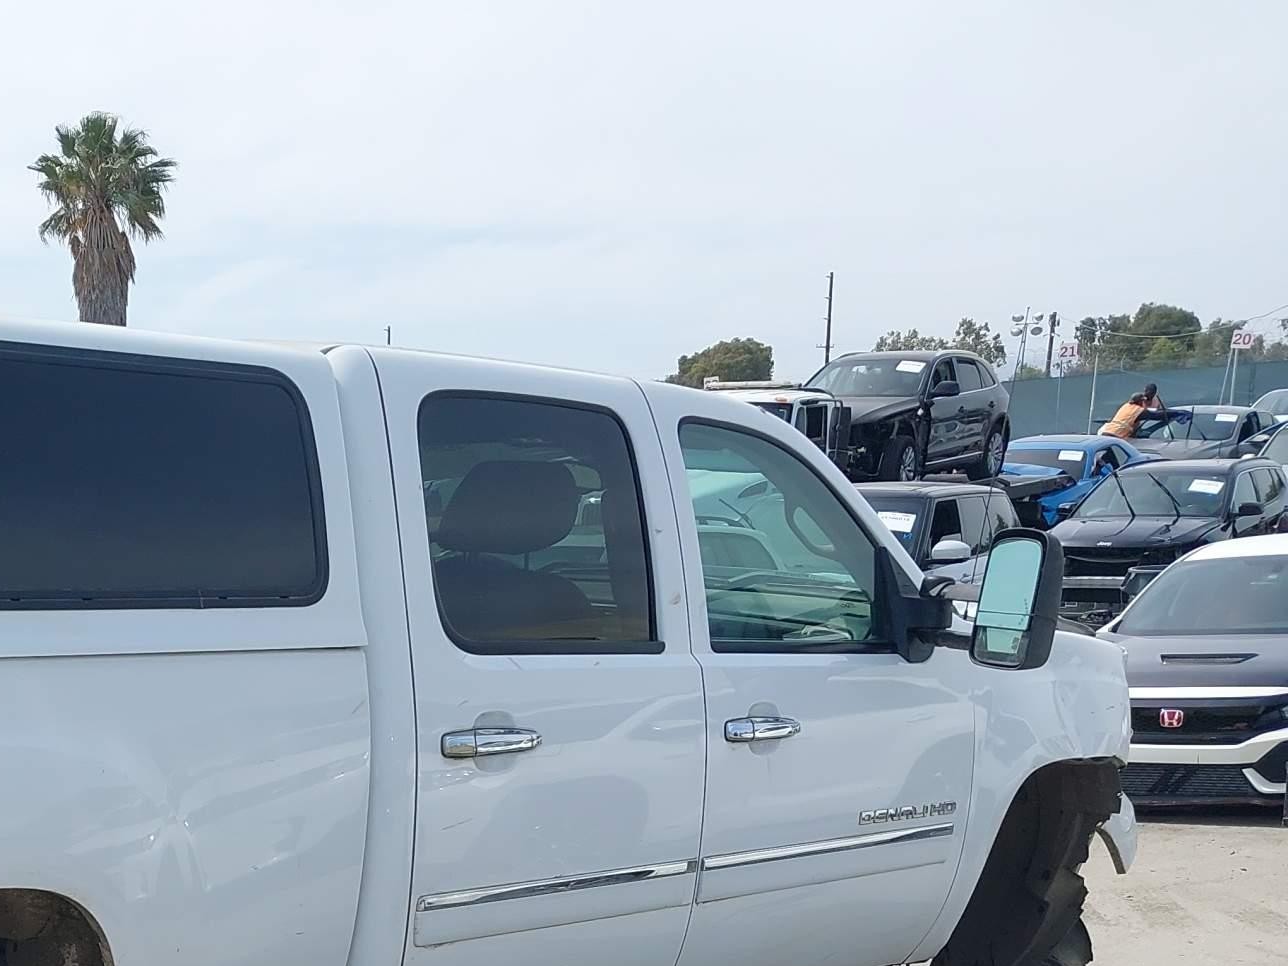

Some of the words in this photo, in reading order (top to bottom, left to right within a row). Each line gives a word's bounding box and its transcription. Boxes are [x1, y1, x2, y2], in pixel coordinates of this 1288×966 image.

[1232, 332, 1253, 346] 20
[1059, 345, 1077, 358] 21
[858, 805, 929, 826] DENALI
